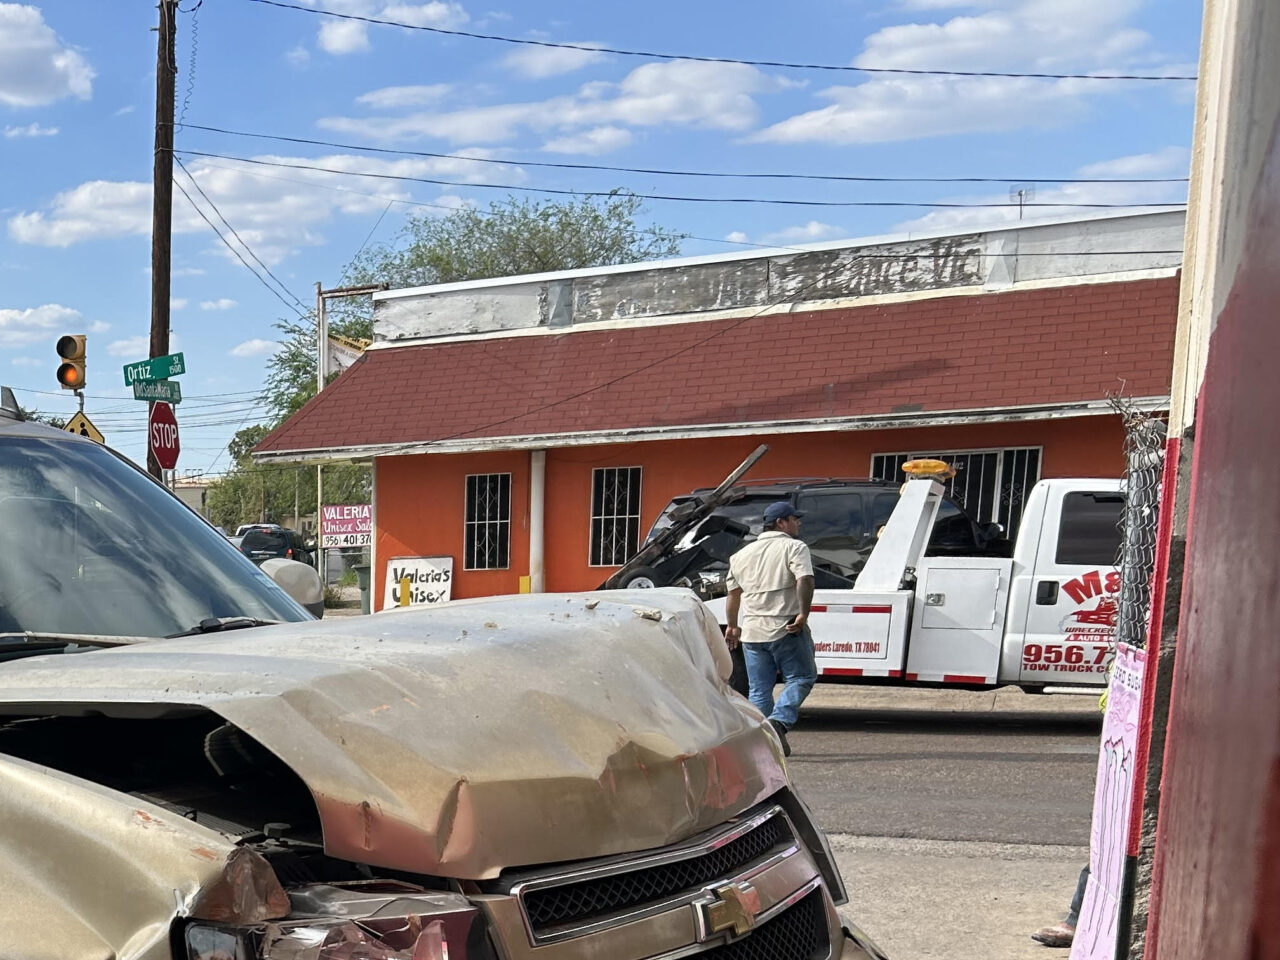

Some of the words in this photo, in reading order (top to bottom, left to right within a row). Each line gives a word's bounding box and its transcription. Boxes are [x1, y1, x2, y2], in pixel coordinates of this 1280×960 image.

[127, 364, 152, 382] Ortiz
[152, 422, 178, 449] STOP
[323, 521, 353, 533] Unisex
[392, 567, 450, 585] Valeria's
[855, 642, 863, 653] TX
[1053, 665, 1093, 673] TRUCK
